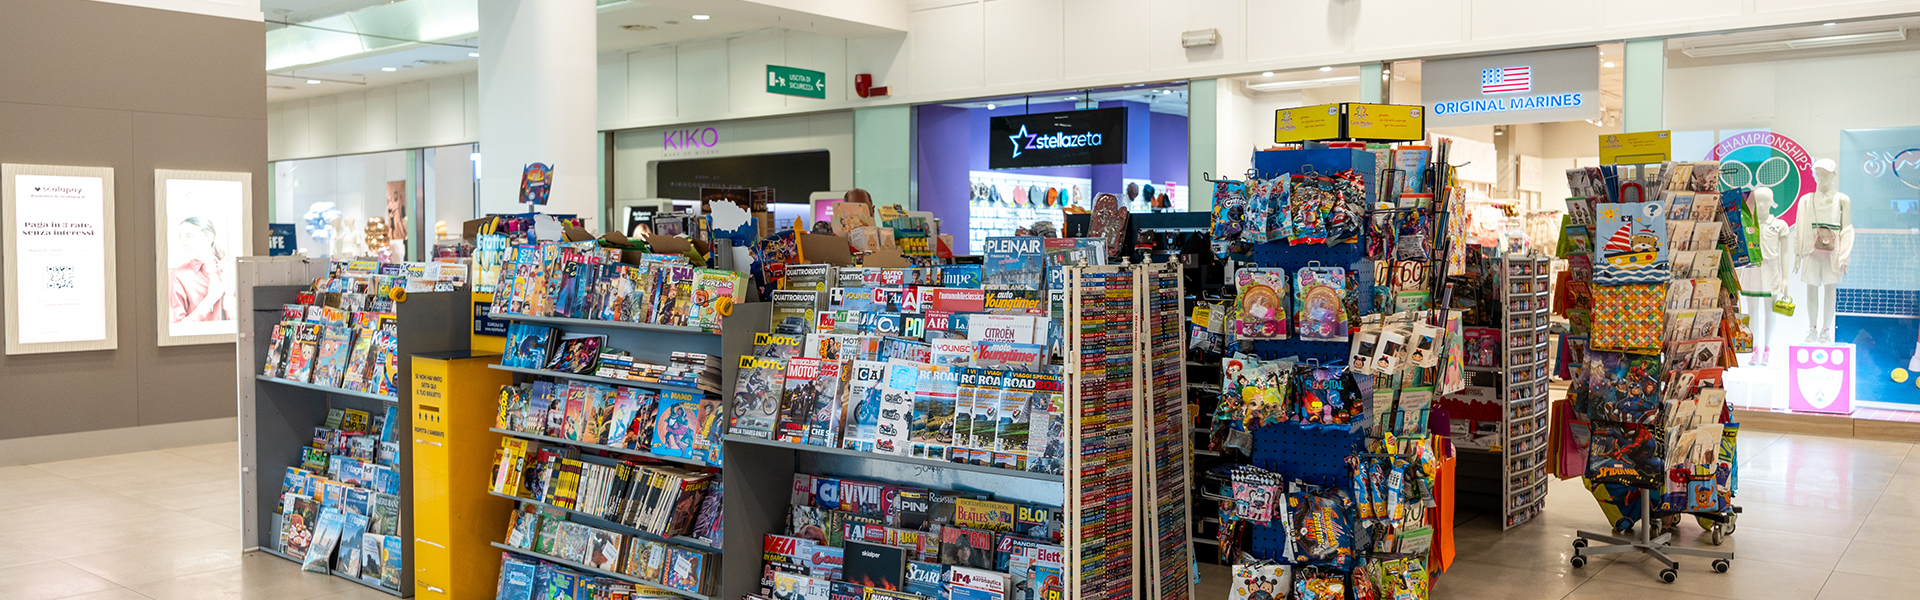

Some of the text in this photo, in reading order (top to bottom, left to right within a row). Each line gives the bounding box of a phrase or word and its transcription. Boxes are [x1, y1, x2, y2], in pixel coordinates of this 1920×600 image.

[789, 74, 805, 82] USCITA
[789, 82, 814, 91] SICUREZZA
[1434, 98, 1506, 115] ORIGINAL
[1510, 93, 1582, 110] MARINES
[663, 127, 719, 150] KIKO
[1715, 133, 1812, 171] CHAMPIONSHIPS
[670, 182, 743, 190] KIKOCOSMETICS.COM
[24, 221, 49, 229] Paga
[563, 248, 601, 265] linus
[987, 239, 1041, 257] PLEINAIR
[985, 293, 1040, 311] Youngtimer
[985, 326, 1015, 339] CITROËN
[978, 344, 1038, 364] Youngtimer
[992, 343, 1011, 351] moto
[1003, 377, 1063, 391] ROADBOO
[958, 505, 989, 524] BEATLES
[764, 535, 796, 556] VELA
